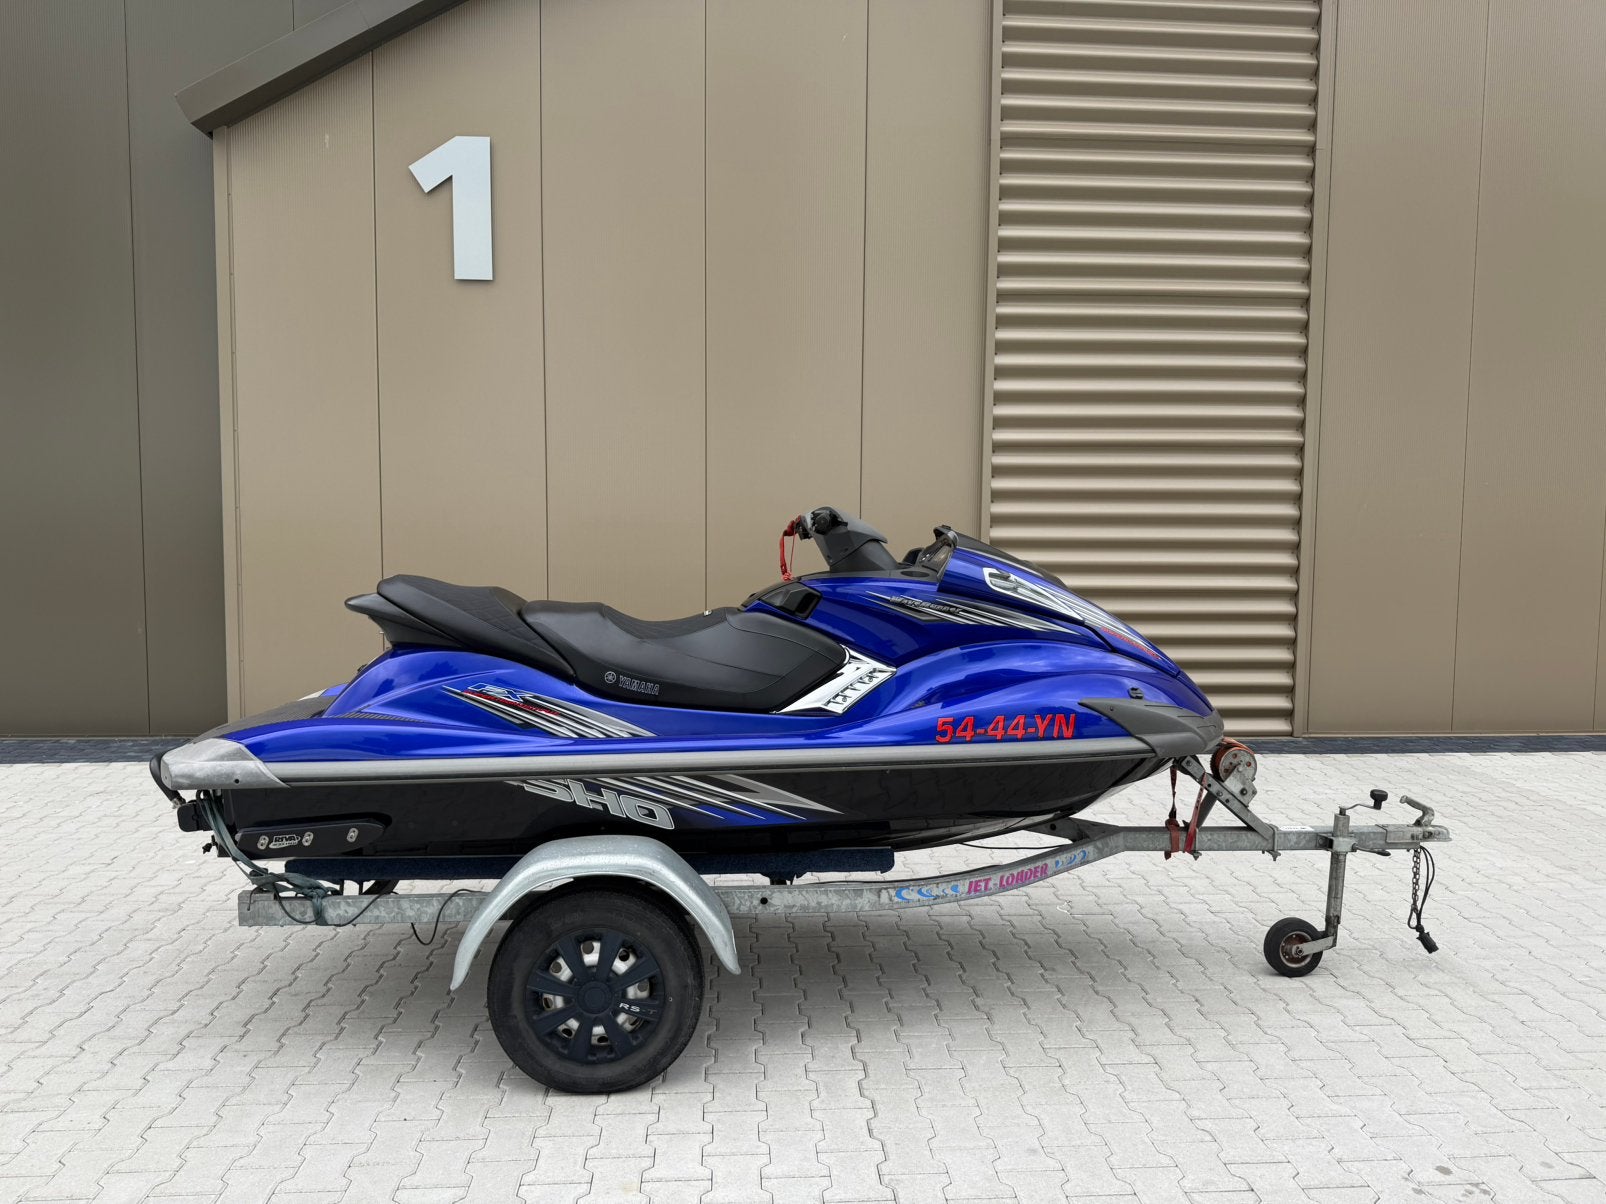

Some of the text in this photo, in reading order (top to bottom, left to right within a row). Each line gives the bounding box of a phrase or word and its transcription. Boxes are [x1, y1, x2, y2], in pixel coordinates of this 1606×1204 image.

[408, 136, 493, 280] 1
[619, 675, 660, 695] YAMAHA
[936, 713, 1076, 743] 54-44-YN
[523, 779, 675, 830] SHO
[967, 863, 1049, 895] JET LOADER
